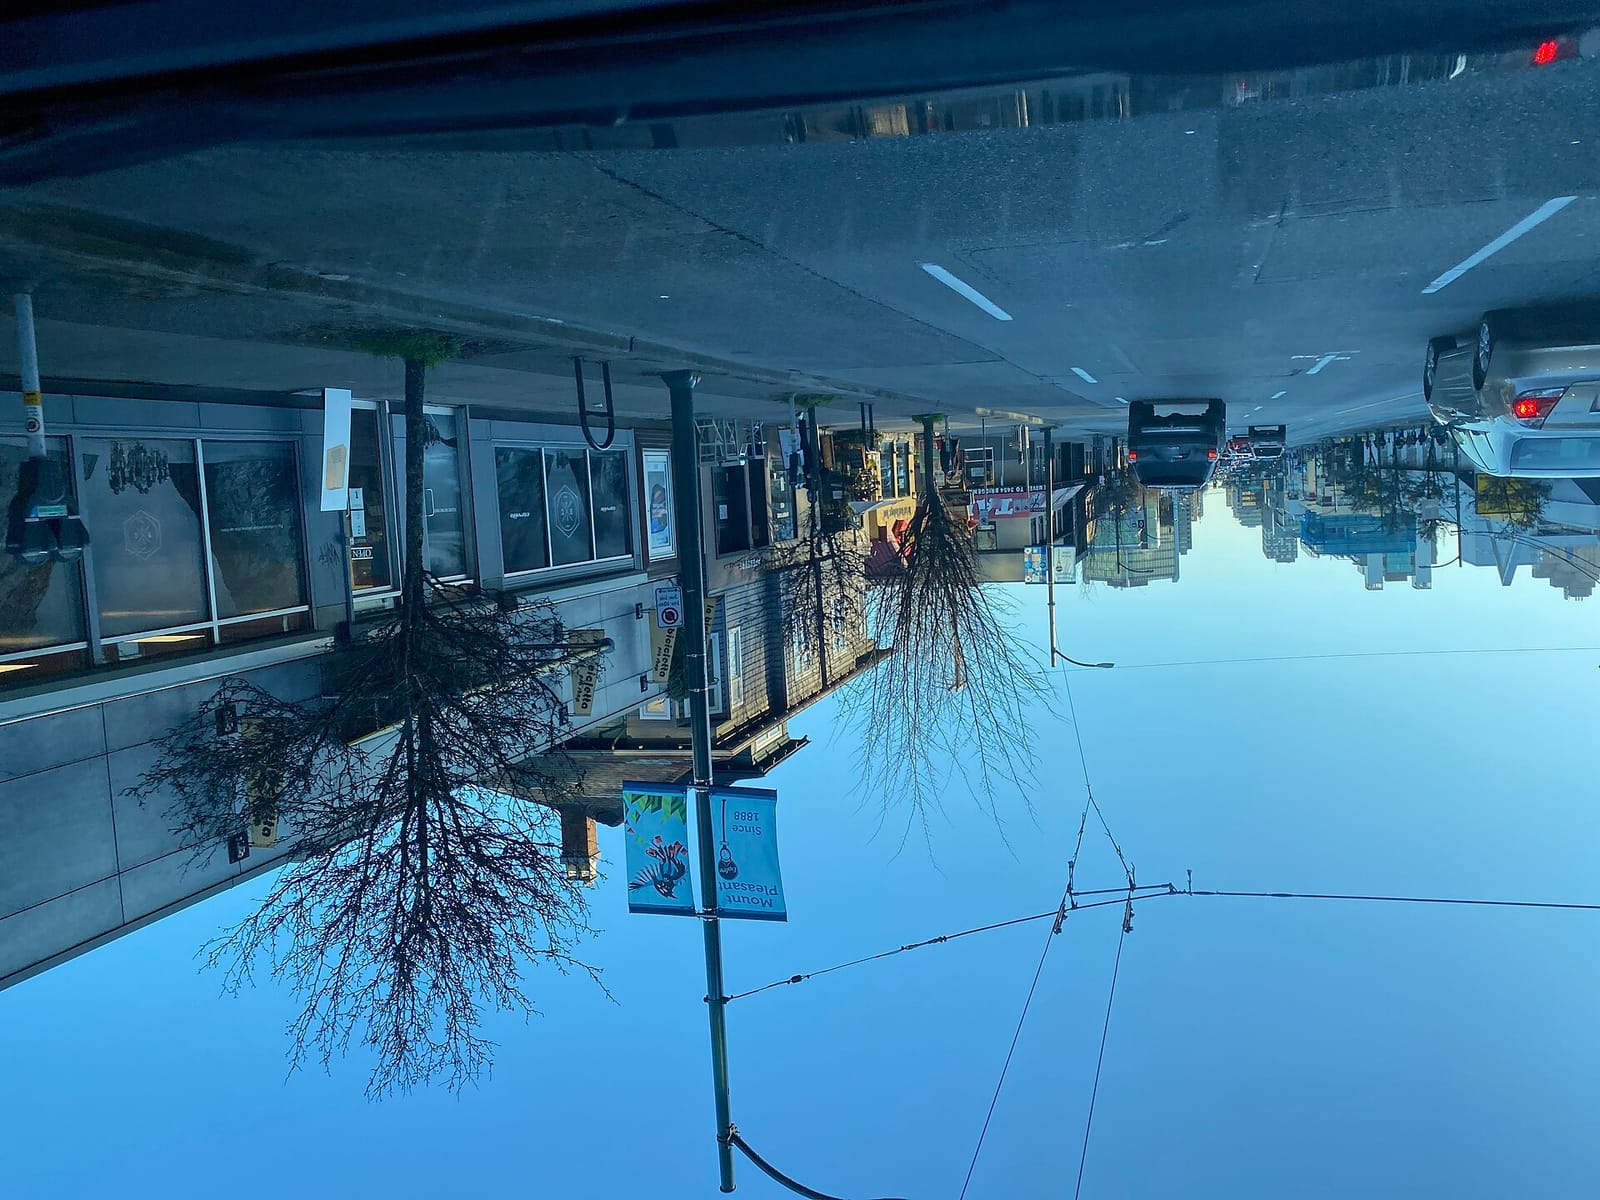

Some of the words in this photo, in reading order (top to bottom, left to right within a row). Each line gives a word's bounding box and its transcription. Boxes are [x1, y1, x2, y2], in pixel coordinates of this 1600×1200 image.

[352, 549, 372, 557] OPEN
[659, 628, 675, 678] bicicletta
[734, 810, 760, 821] 1888
[732, 824, 762, 836] Since
[718, 882, 778, 896] Pleasant
[726, 894, 774, 908] Mount
